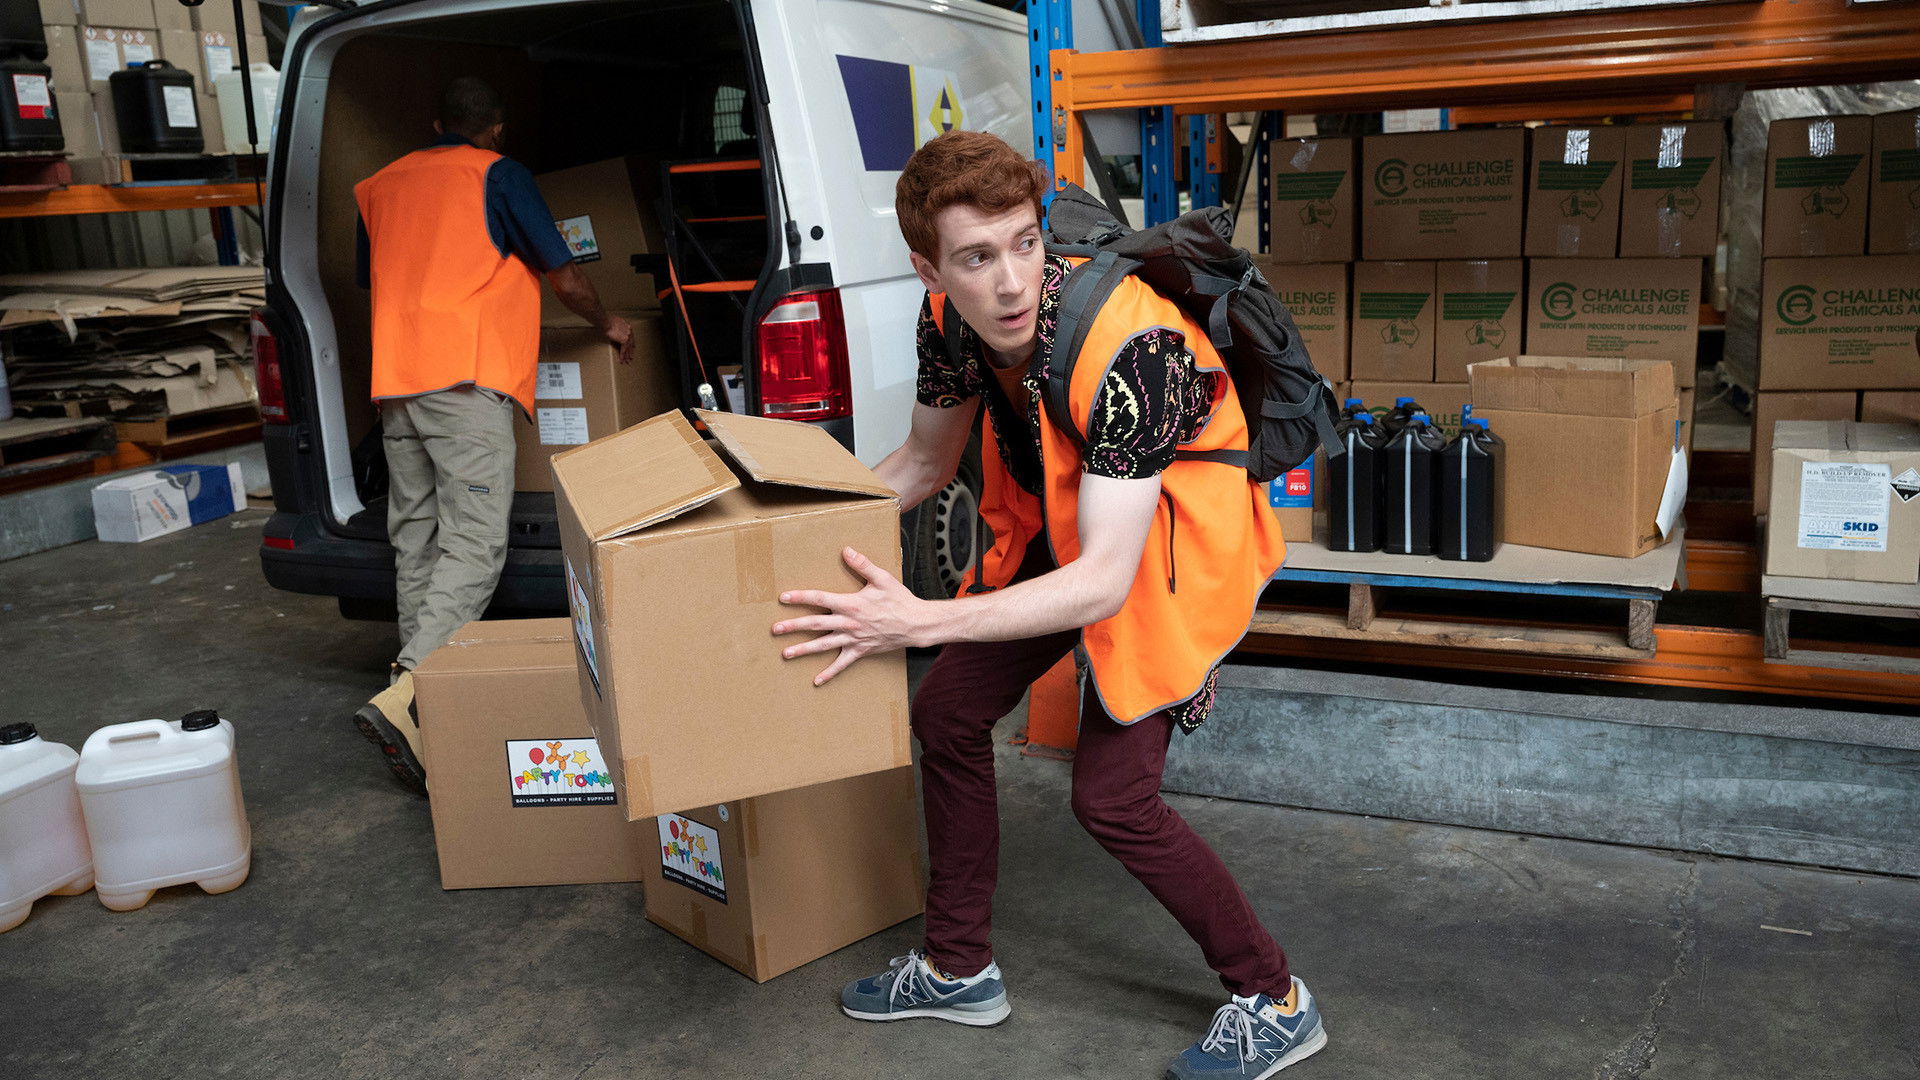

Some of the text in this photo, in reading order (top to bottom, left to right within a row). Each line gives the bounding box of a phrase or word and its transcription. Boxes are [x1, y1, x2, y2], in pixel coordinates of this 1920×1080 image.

[1413, 159, 1514, 177] CHALLENGE
[1413, 175, 1513, 189] CHEMICALS AUST.
[1466, 194, 1512, 203] TECHNOLOGY
[1279, 292, 1336, 304] LLENGE
[1582, 288, 1690, 303] CHALLENGE
[1309, 305, 1335, 316] AUST.
[1582, 303, 1688, 315] CHEMICALS AUST.
[1822, 304, 1904, 318] CHEMICALS
[1540, 322, 1688, 332] SERVICE WITH PRODUCTS OF TECHNOLOGY
[1776, 327, 1806, 335] SERVICE
[1808, 327, 1828, 335] WITH
[1829, 326, 1872, 334] PRODUCTS
[1874, 325, 1885, 333] OF
[514, 767, 612, 790] PARTY TOWN
[663, 841, 723, 883] PARTY TOWN
